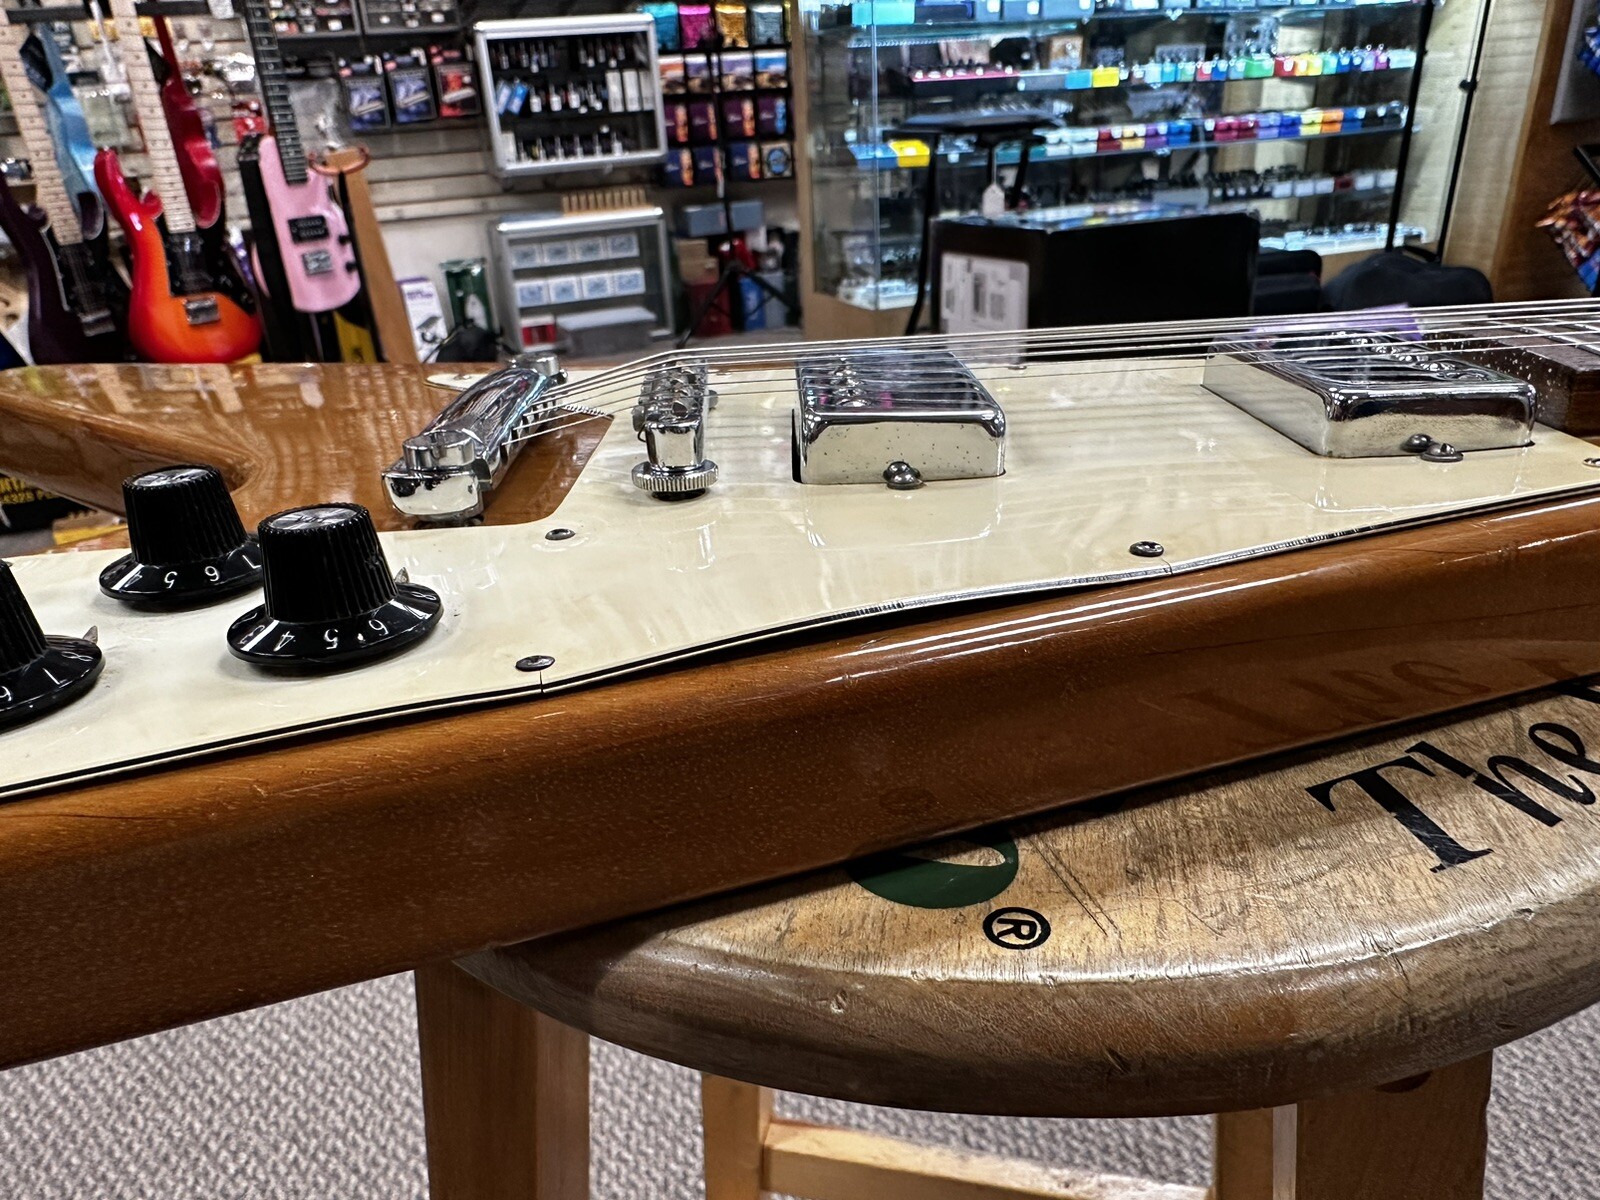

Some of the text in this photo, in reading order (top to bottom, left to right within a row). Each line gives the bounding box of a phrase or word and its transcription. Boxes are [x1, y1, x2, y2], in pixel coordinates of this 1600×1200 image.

[164, 571, 178, 589] 5
[204, 565, 220, 582] 6
[273, 630, 296, 651] 4
[323, 628, 339, 650] 5
[368, 619, 389, 636] 6
[1304, 722, 1600, 874] The
